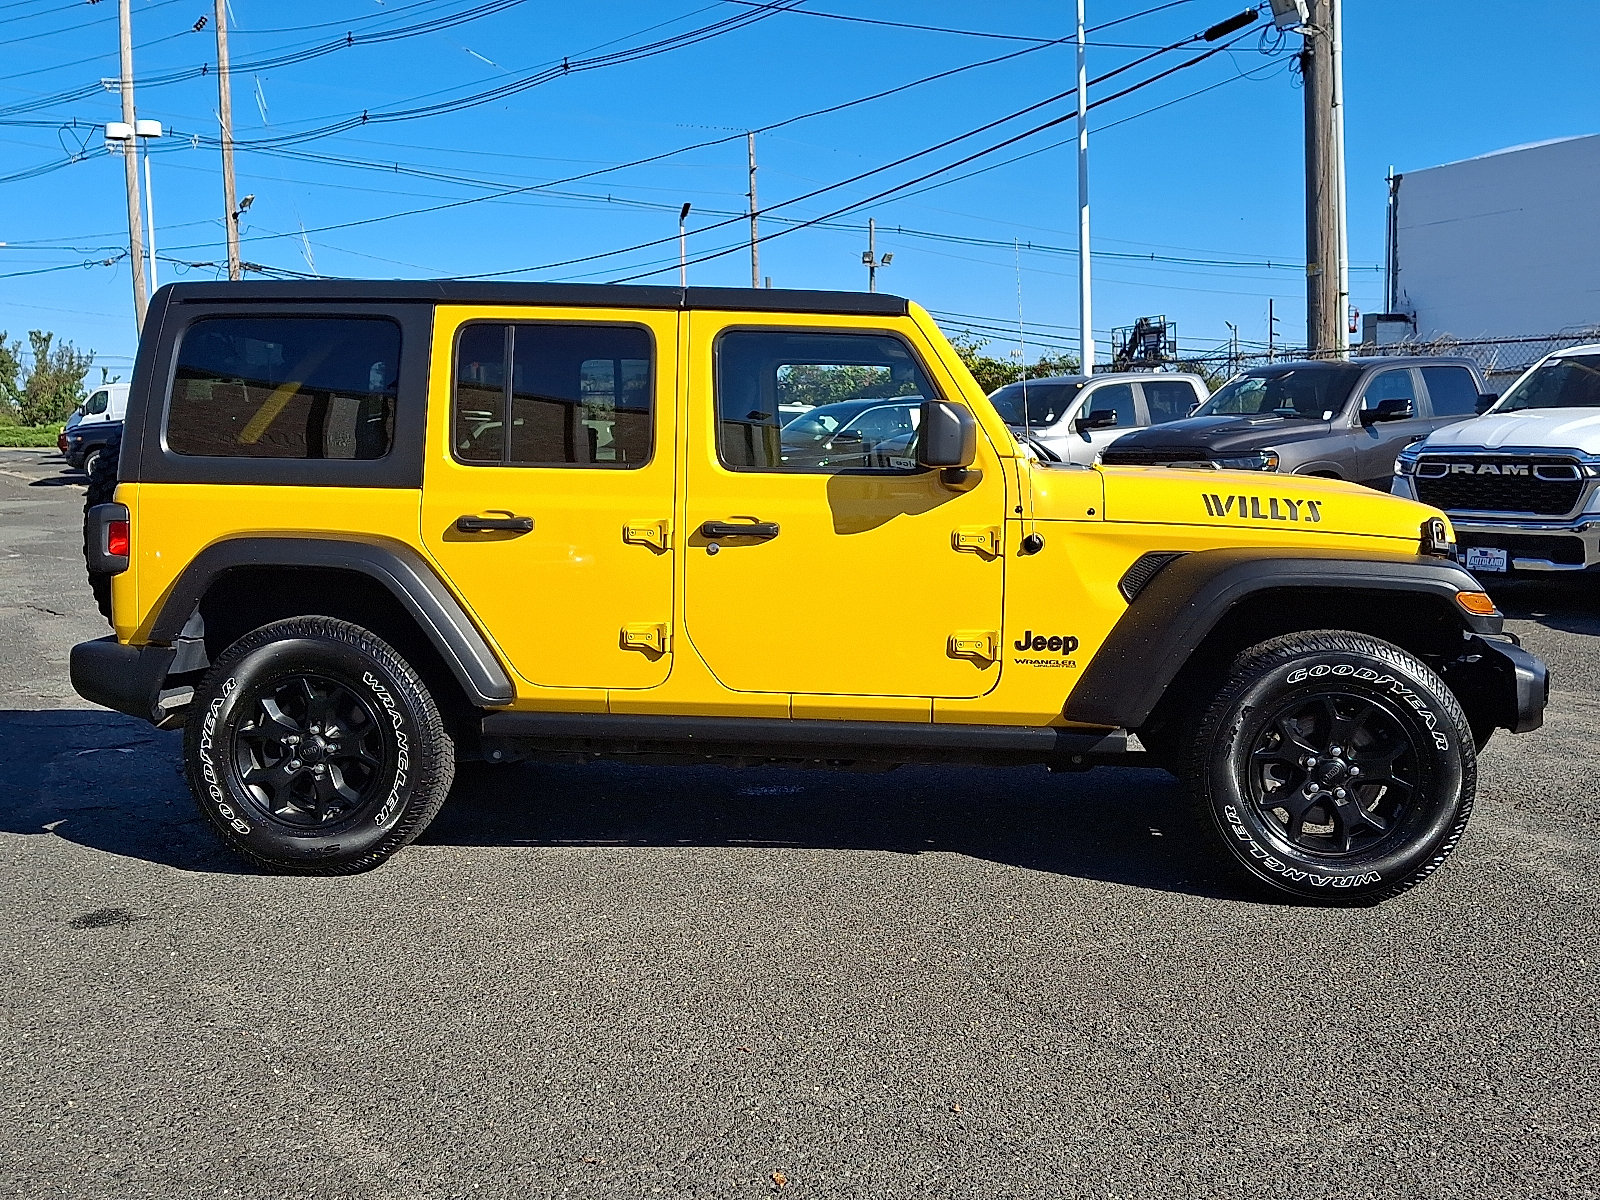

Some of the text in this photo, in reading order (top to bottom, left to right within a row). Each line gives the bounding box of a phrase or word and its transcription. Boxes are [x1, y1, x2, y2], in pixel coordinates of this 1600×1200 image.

[1451, 464, 1529, 476] RAM
[1201, 493, 1322, 522] WILLYS
[1469, 556, 1504, 567] AUTOLAND
[1014, 630, 1079, 655] Jeep
[1014, 658, 1076, 666] WRANGLER
[1286, 665, 1449, 751] GOODYEAR
[200, 677, 251, 835] GOODYEAR
[362, 671, 409, 826] WRANGLER
[1224, 804, 1382, 888] WRANGLER
